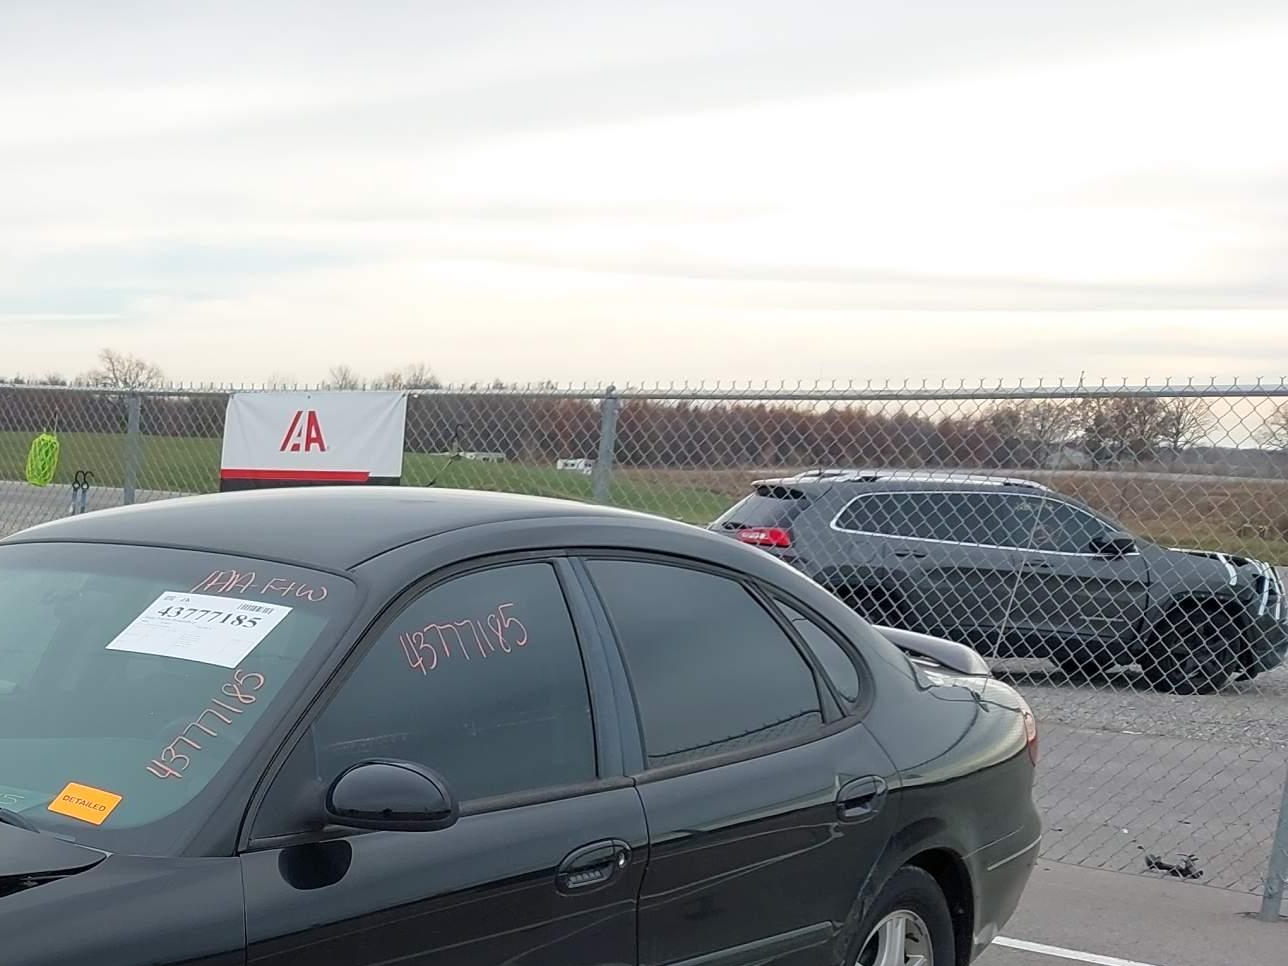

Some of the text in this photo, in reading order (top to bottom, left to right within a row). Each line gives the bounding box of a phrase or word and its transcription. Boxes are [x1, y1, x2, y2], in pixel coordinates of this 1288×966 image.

[158, 606, 262, 629] 43777185
[399, 602, 528, 676] 43777185
[146, 668, 265, 779] 43777185
[62, 794, 107, 812] DETAILED
